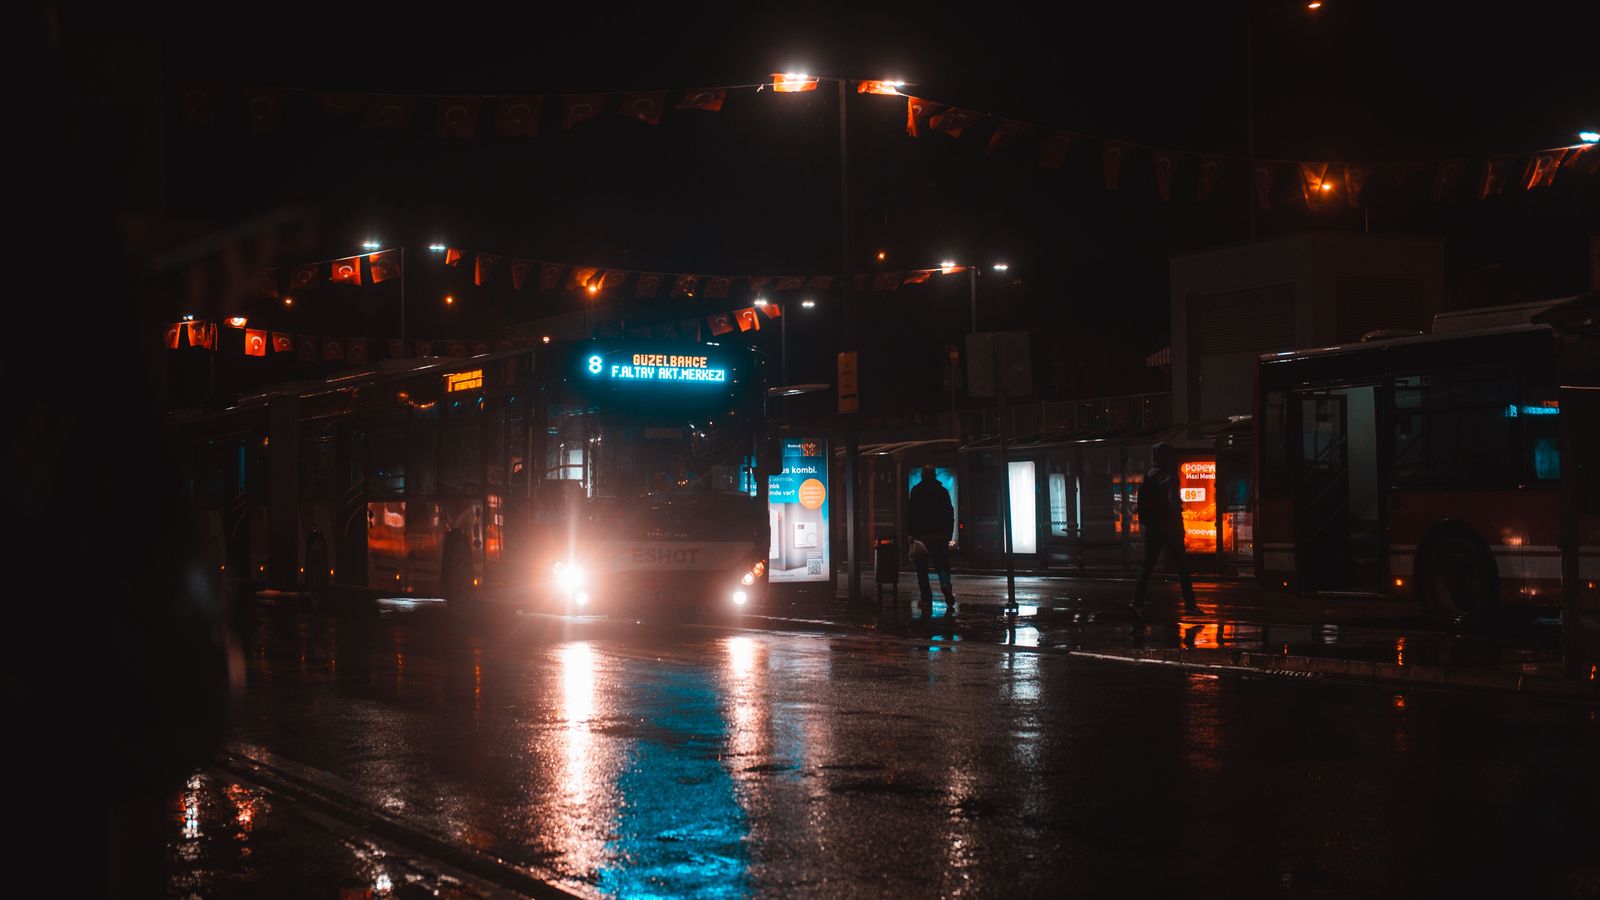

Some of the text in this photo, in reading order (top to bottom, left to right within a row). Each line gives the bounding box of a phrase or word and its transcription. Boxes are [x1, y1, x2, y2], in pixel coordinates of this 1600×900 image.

[588, 355, 602, 374] 8
[633, 353, 708, 369] GUZELBAHCE
[611, 365, 655, 380] F.ALTAY
[1185, 490, 1197, 500] 89
[632, 548, 701, 564] ESHOT
